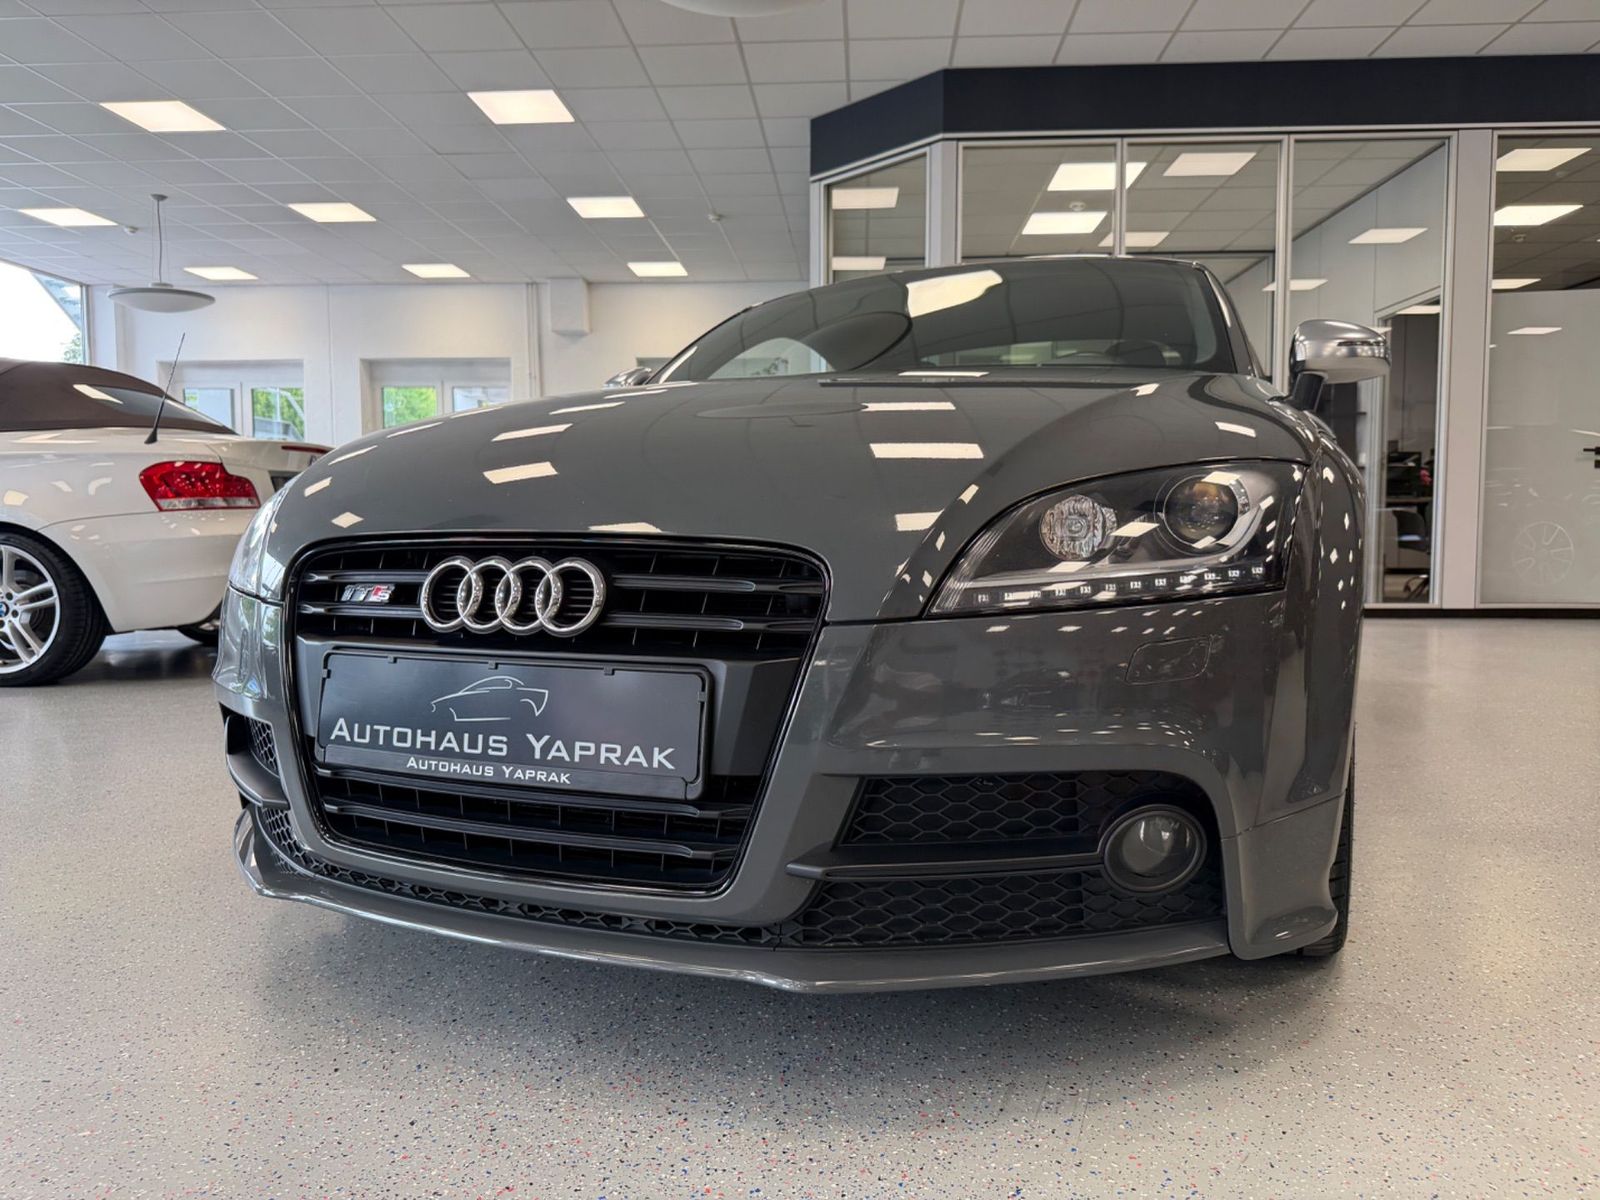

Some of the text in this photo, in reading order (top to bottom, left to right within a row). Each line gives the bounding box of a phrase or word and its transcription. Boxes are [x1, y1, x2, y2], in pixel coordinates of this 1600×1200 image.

[330, 717, 676, 770] AUTOHAUS YAPRAK
[406, 756, 571, 784] AUTOHAUS YAPRAK
